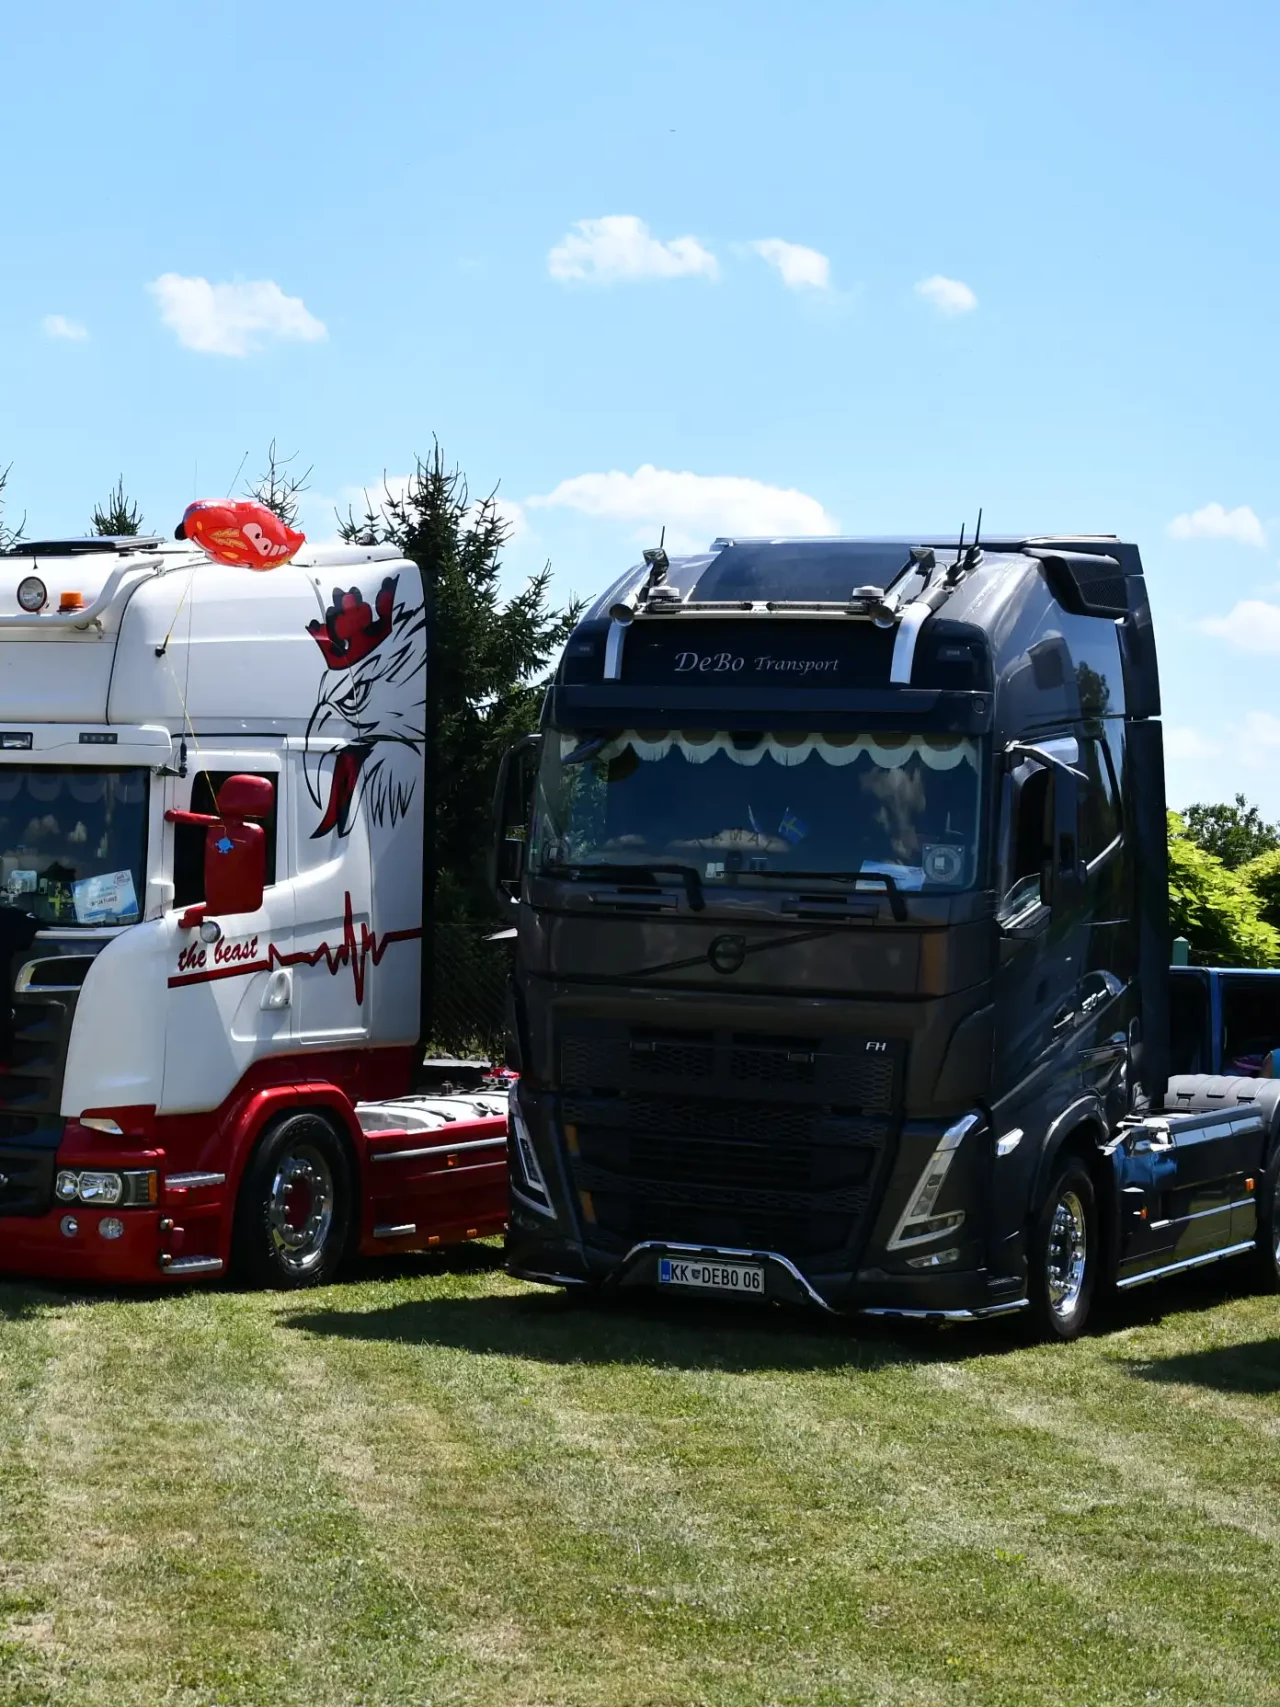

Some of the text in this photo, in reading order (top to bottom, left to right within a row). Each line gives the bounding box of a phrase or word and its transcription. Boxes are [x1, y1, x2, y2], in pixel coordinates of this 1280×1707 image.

[673, 652, 840, 676] DeBo Transport
[178, 935, 258, 972] the beast
[865, 1041, 887, 1052] FH
[671, 1263, 760, 1290] KK DEBO 06
